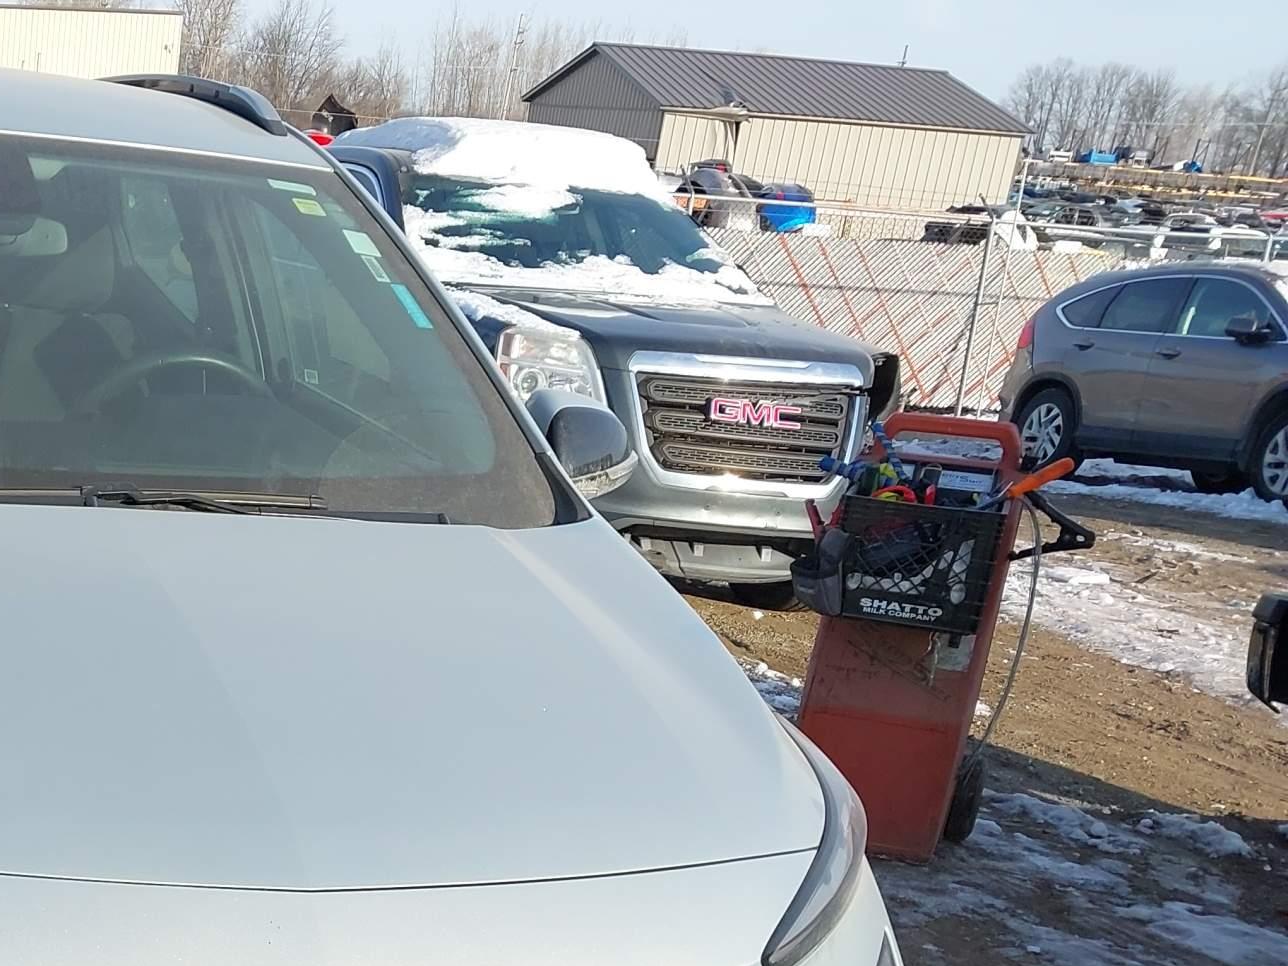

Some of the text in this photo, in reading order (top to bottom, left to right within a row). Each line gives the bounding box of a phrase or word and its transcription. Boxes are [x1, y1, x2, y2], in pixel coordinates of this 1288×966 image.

[711, 398, 801, 429] GMC
[859, 597, 943, 617] SHATTO
[862, 607, 937, 622] MILK COMPANY
